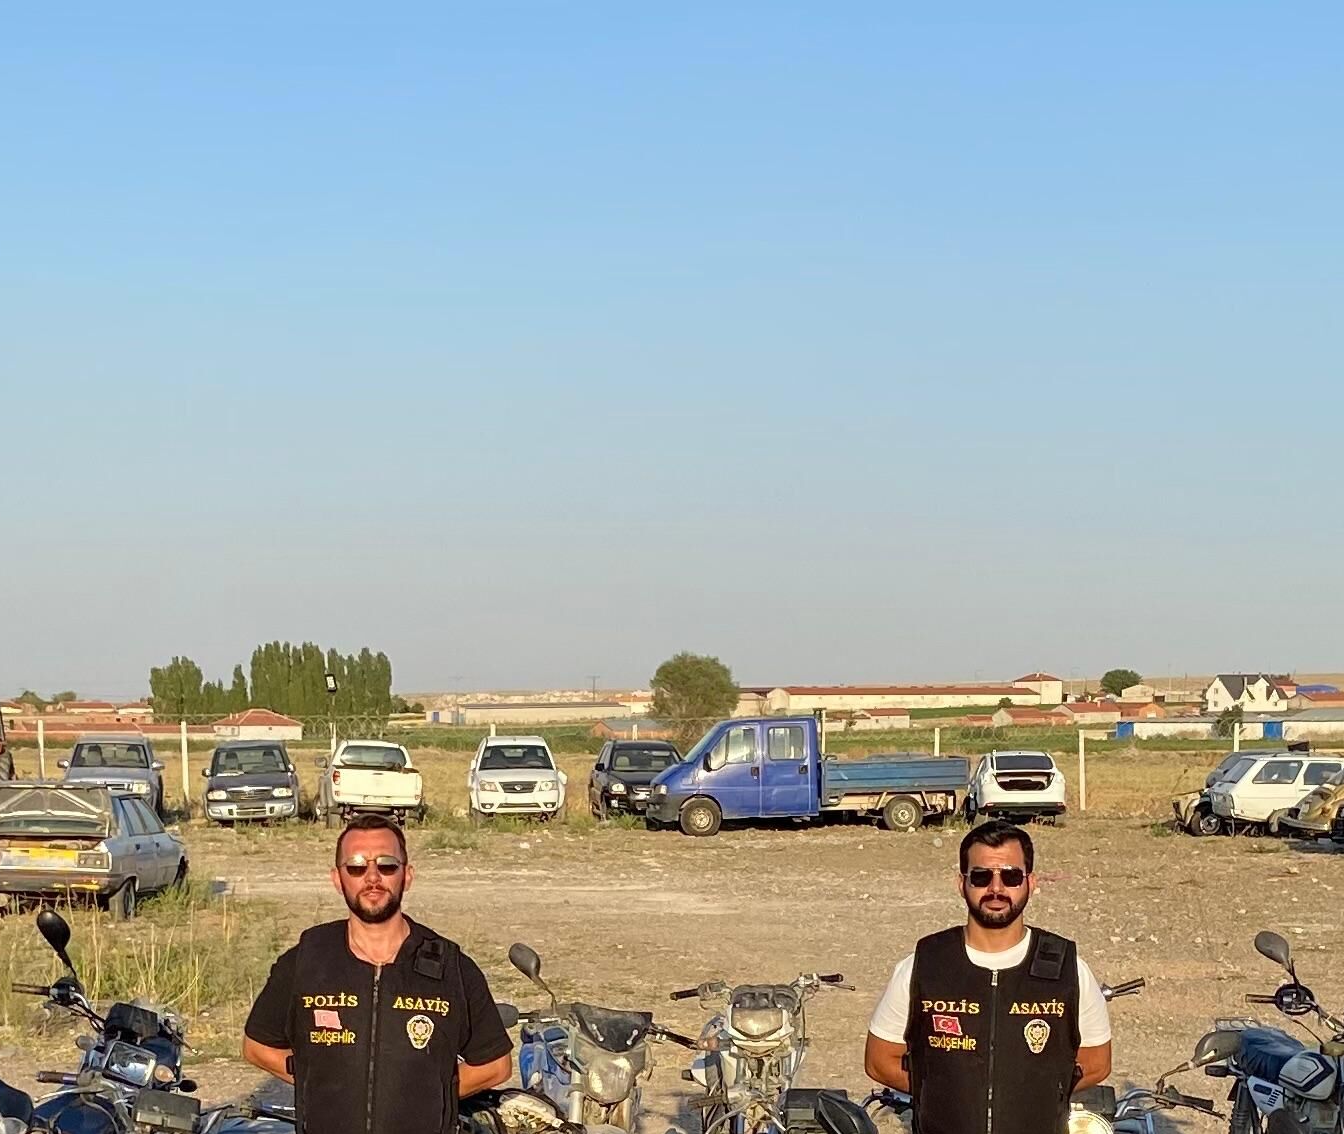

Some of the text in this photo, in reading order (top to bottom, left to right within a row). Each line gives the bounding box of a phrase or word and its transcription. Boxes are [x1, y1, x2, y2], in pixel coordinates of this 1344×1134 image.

[302, 992, 450, 1017] POLİS ASAYİŞ
[921, 998, 1065, 1017] POLİS ASAYİŞ
[310, 1029, 356, 1047] ESKİŞEHİR
[928, 1034, 977, 1052] ESKİŞEHİR
